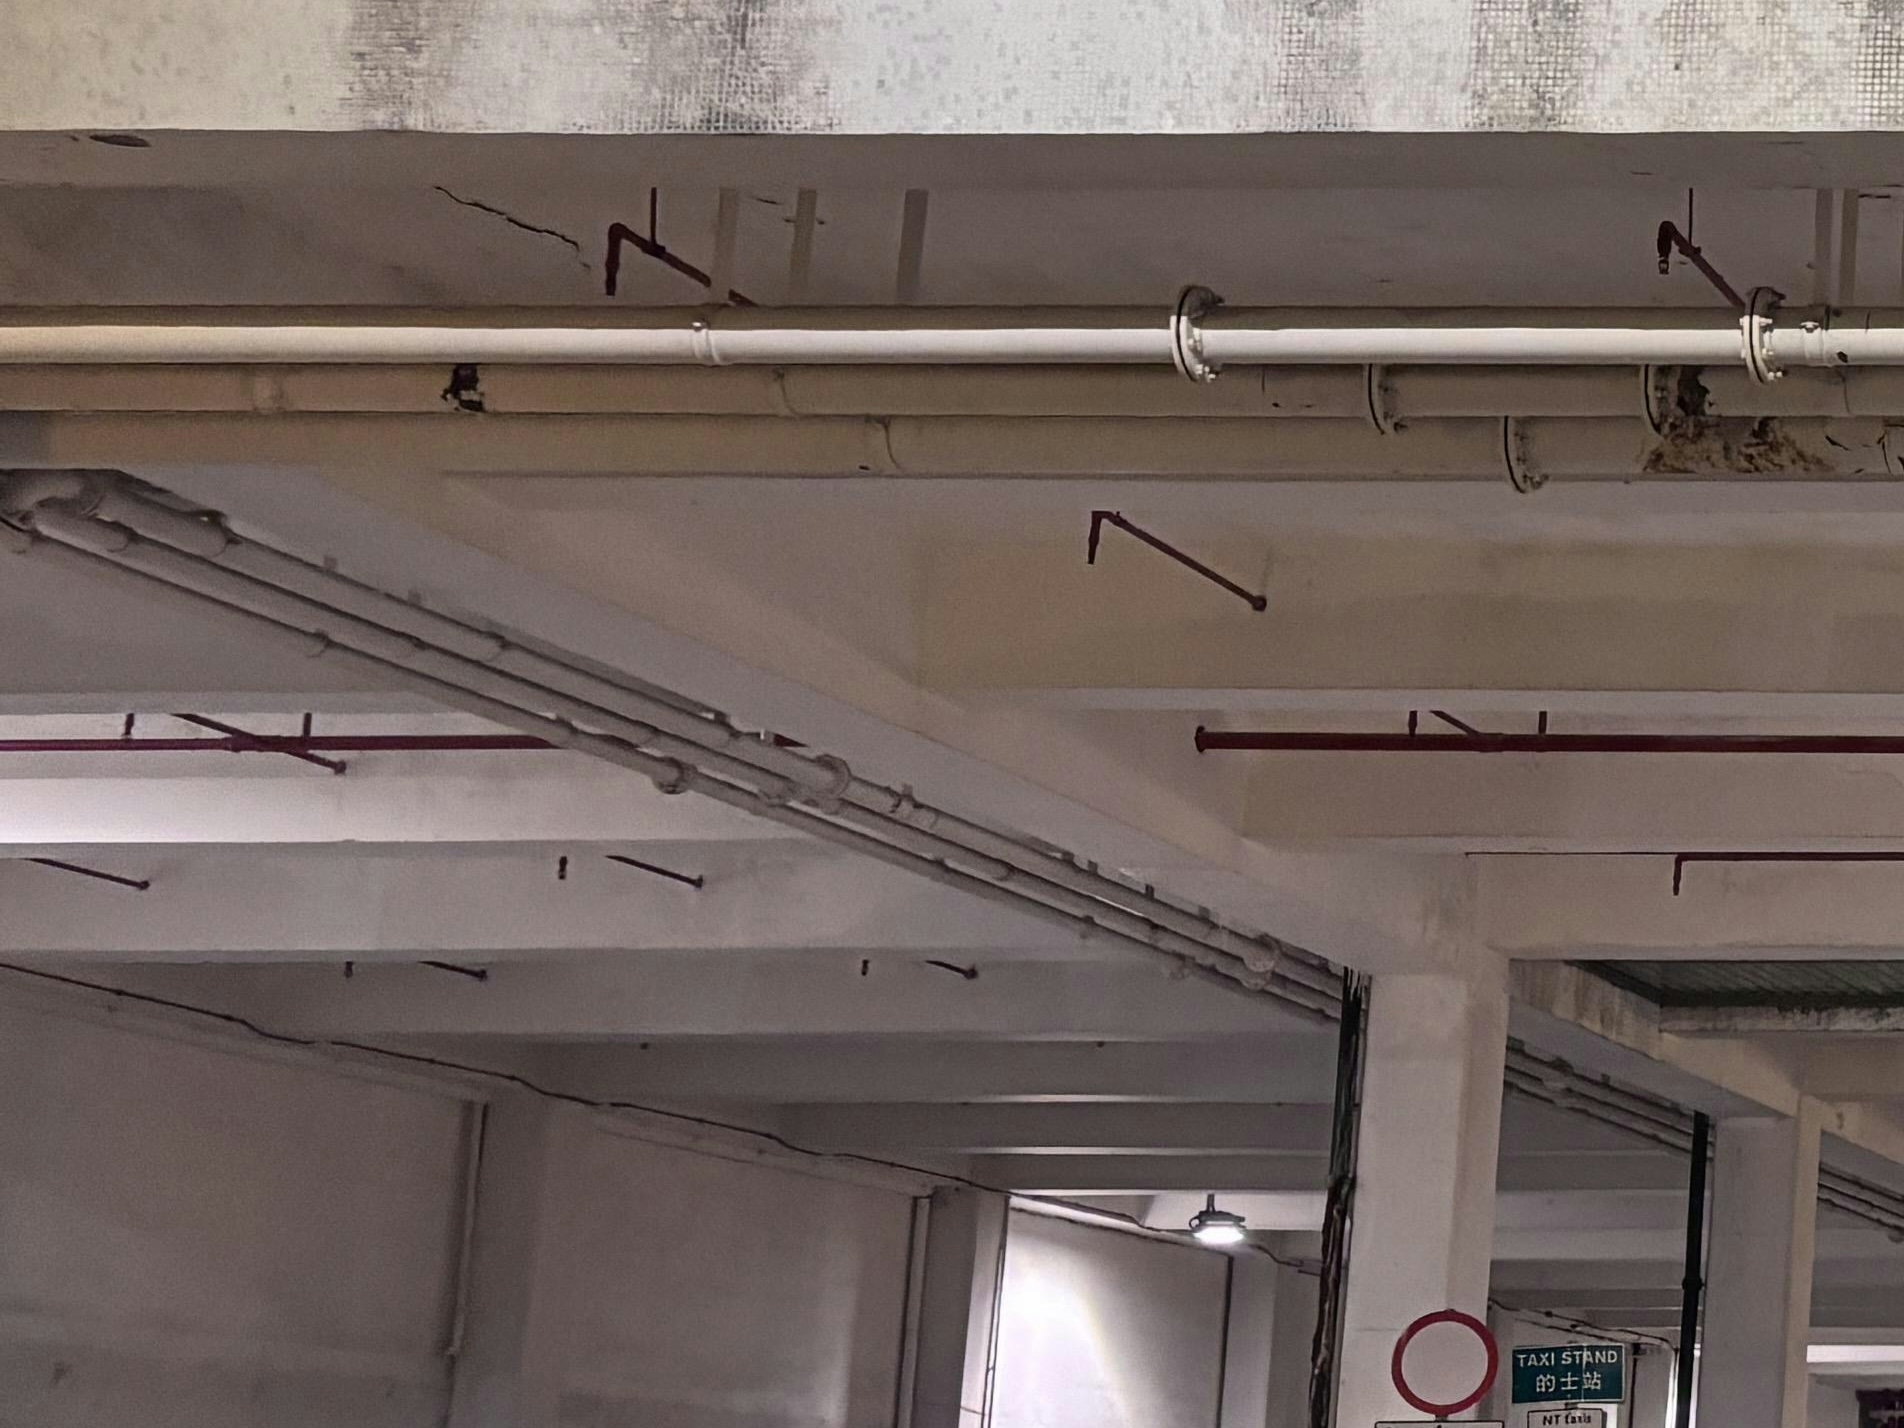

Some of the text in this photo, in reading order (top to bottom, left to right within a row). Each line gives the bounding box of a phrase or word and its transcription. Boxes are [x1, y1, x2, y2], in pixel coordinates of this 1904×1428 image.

[1516, 1350, 1618, 1368] TAXI STAND
[1535, 1371, 1601, 1393] 的士站
